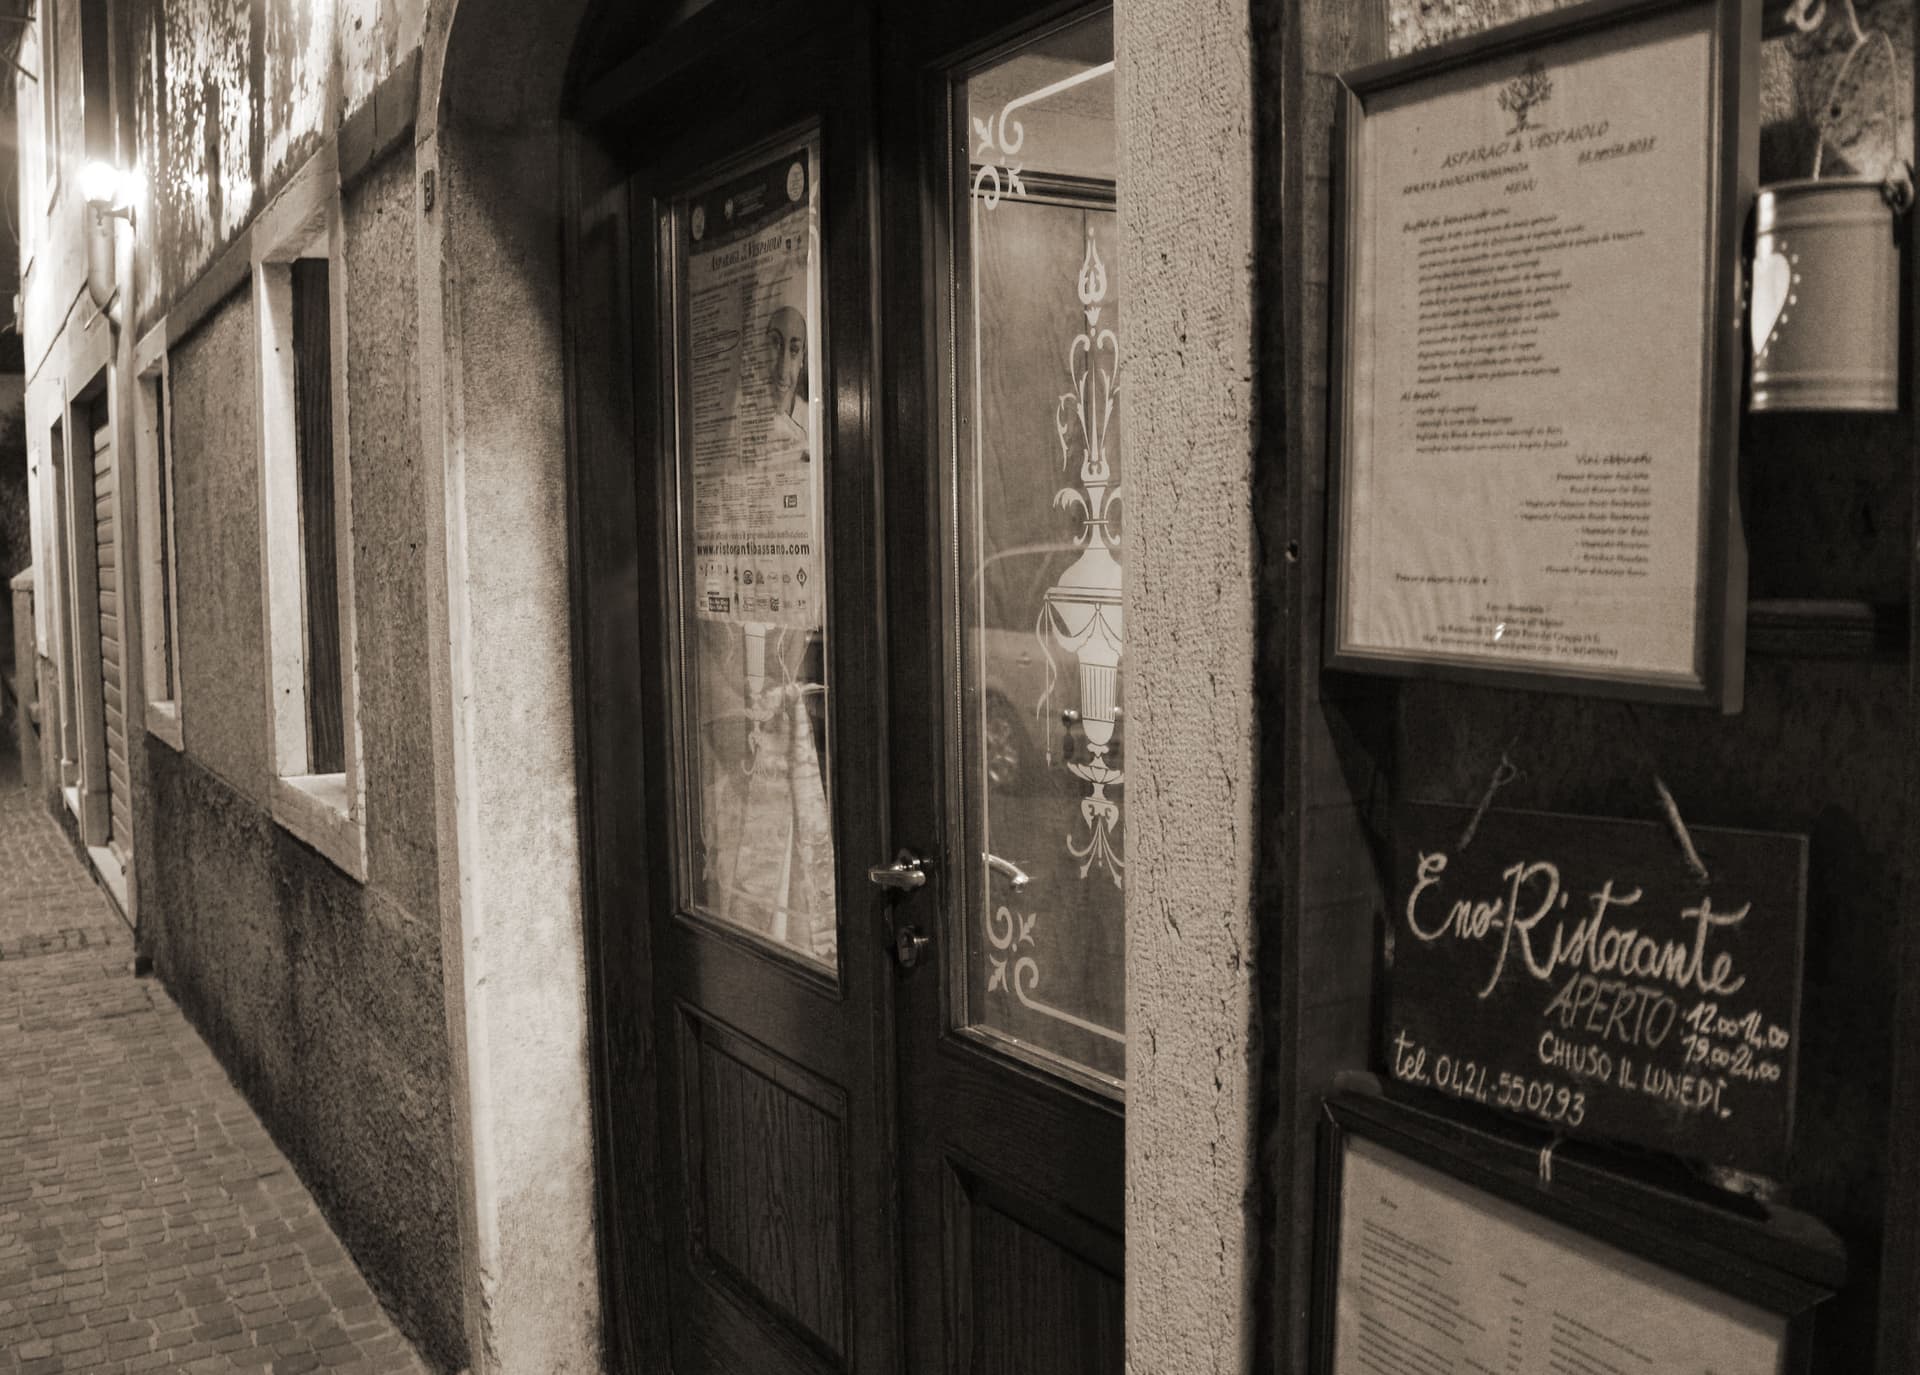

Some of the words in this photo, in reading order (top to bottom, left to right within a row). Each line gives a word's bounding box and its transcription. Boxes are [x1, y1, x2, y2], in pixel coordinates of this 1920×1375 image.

[697, 542, 810, 556] www.ristorantibassano.com
[1538, 1030, 1613, 1082] CHIUSO
[1618, 1056, 1637, 1090] IL
